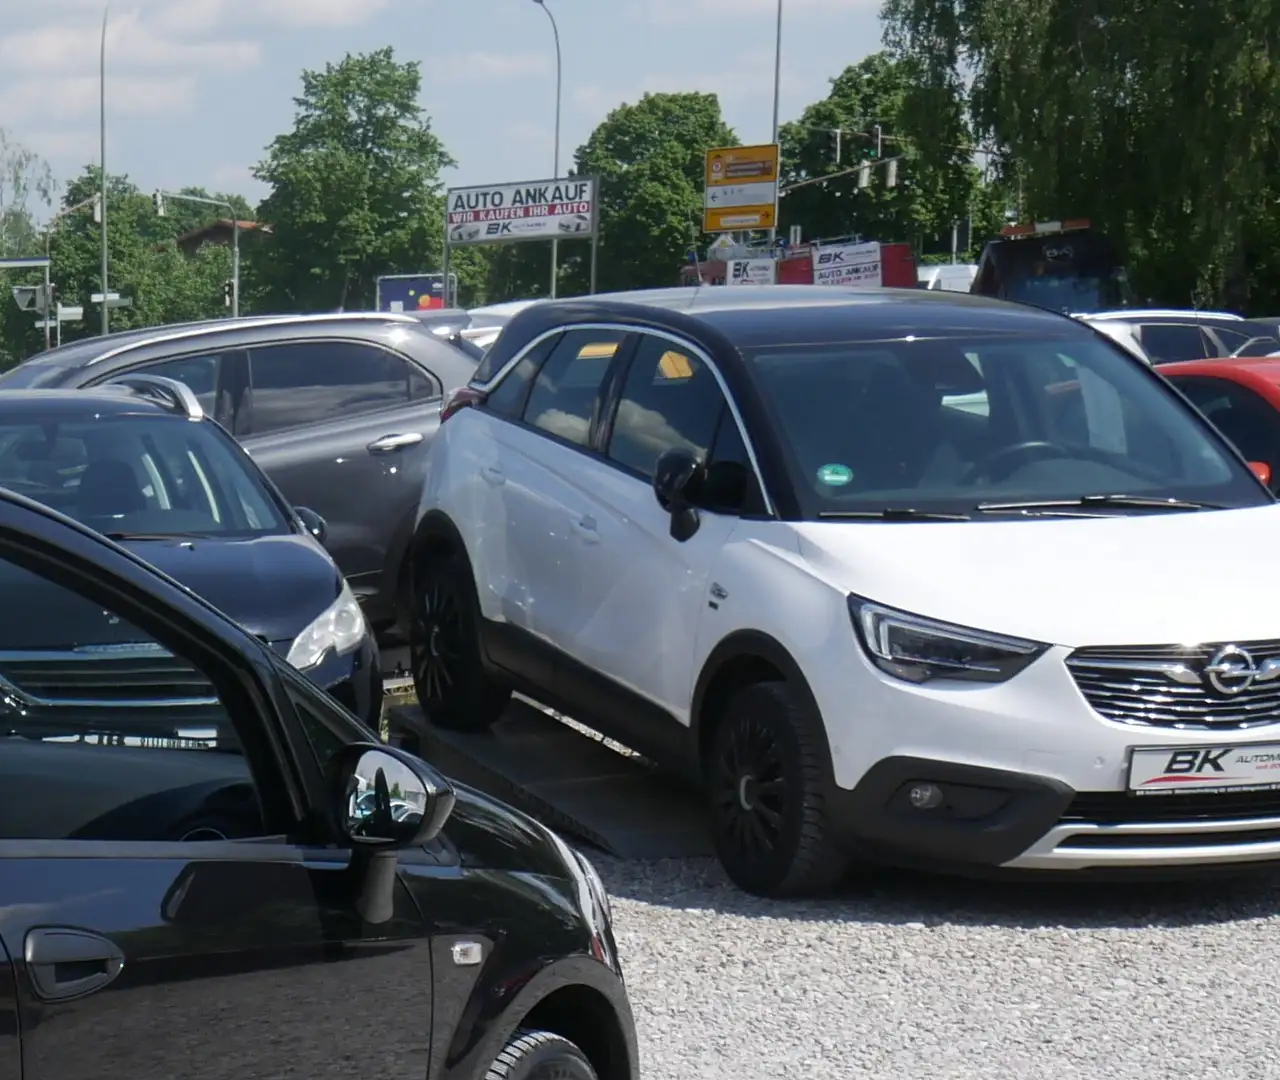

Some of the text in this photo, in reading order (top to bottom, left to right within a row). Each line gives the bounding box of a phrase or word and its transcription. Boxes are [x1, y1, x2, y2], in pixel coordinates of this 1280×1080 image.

[452, 183, 588, 211] AUTO ANKAUF
[452, 202, 588, 223] WIR KAUFEN IHR AUTO
[485, 221, 513, 235] BK
[817, 251, 844, 264] BK
[1163, 748, 1235, 773] BK
